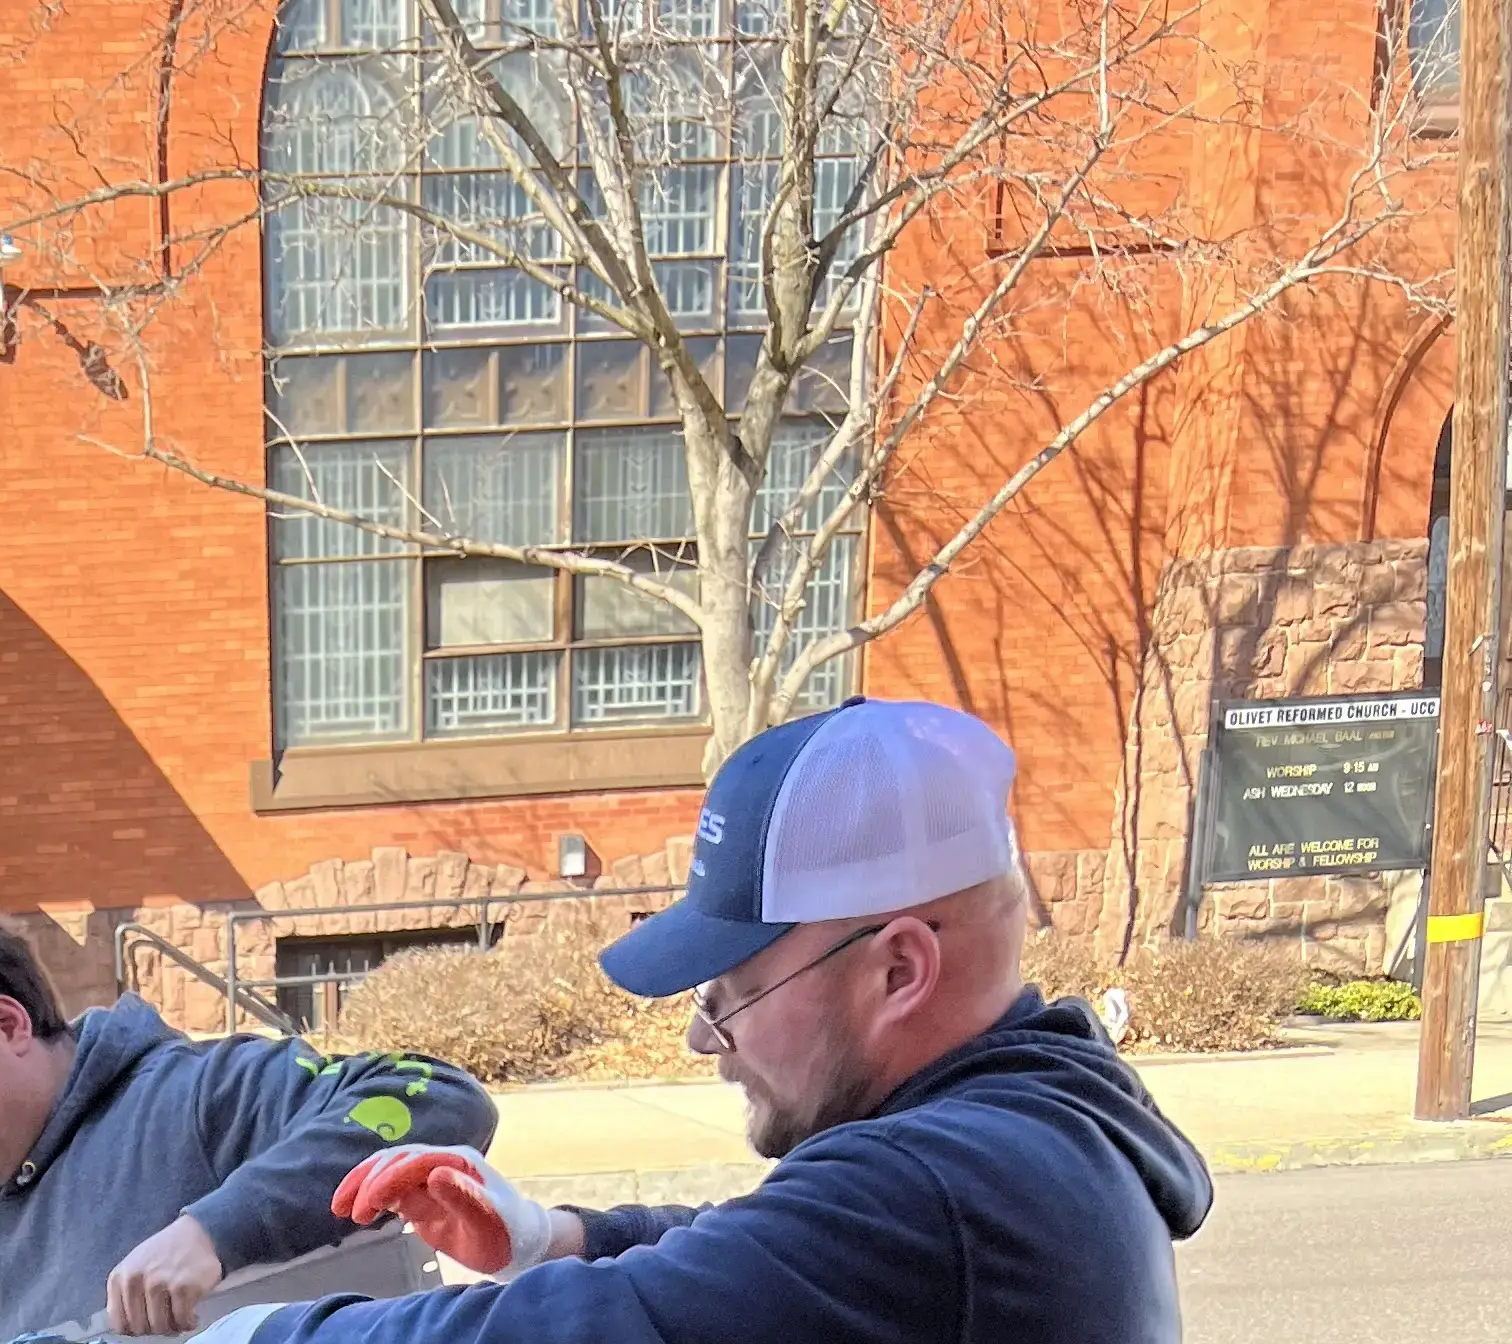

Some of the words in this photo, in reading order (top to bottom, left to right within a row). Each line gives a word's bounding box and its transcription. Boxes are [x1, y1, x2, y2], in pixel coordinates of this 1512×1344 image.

[1230, 709, 1273, 725] OLIVET
[1277, 707, 1343, 722] REFORMED
[1347, 703, 1397, 718] CHURCH
[1411, 701, 1436, 715] UCC
[1267, 764, 1317, 778] WORSHIP
[1243, 786, 1265, 800] ASH
[1271, 783, 1333, 798] WEDNESDAY
[1344, 782, 1354, 793] 12
[699, 807, 726, 844] ES
[1249, 844, 1269, 857] ALL
[1272, 843, 1295, 856] ARE
[1301, 839, 1354, 853] WELCOME
[1357, 838, 1379, 849] FOR
[1248, 859, 1296, 872] WORSHIP
[1313, 852, 1377, 867] FELLOWSHIP
